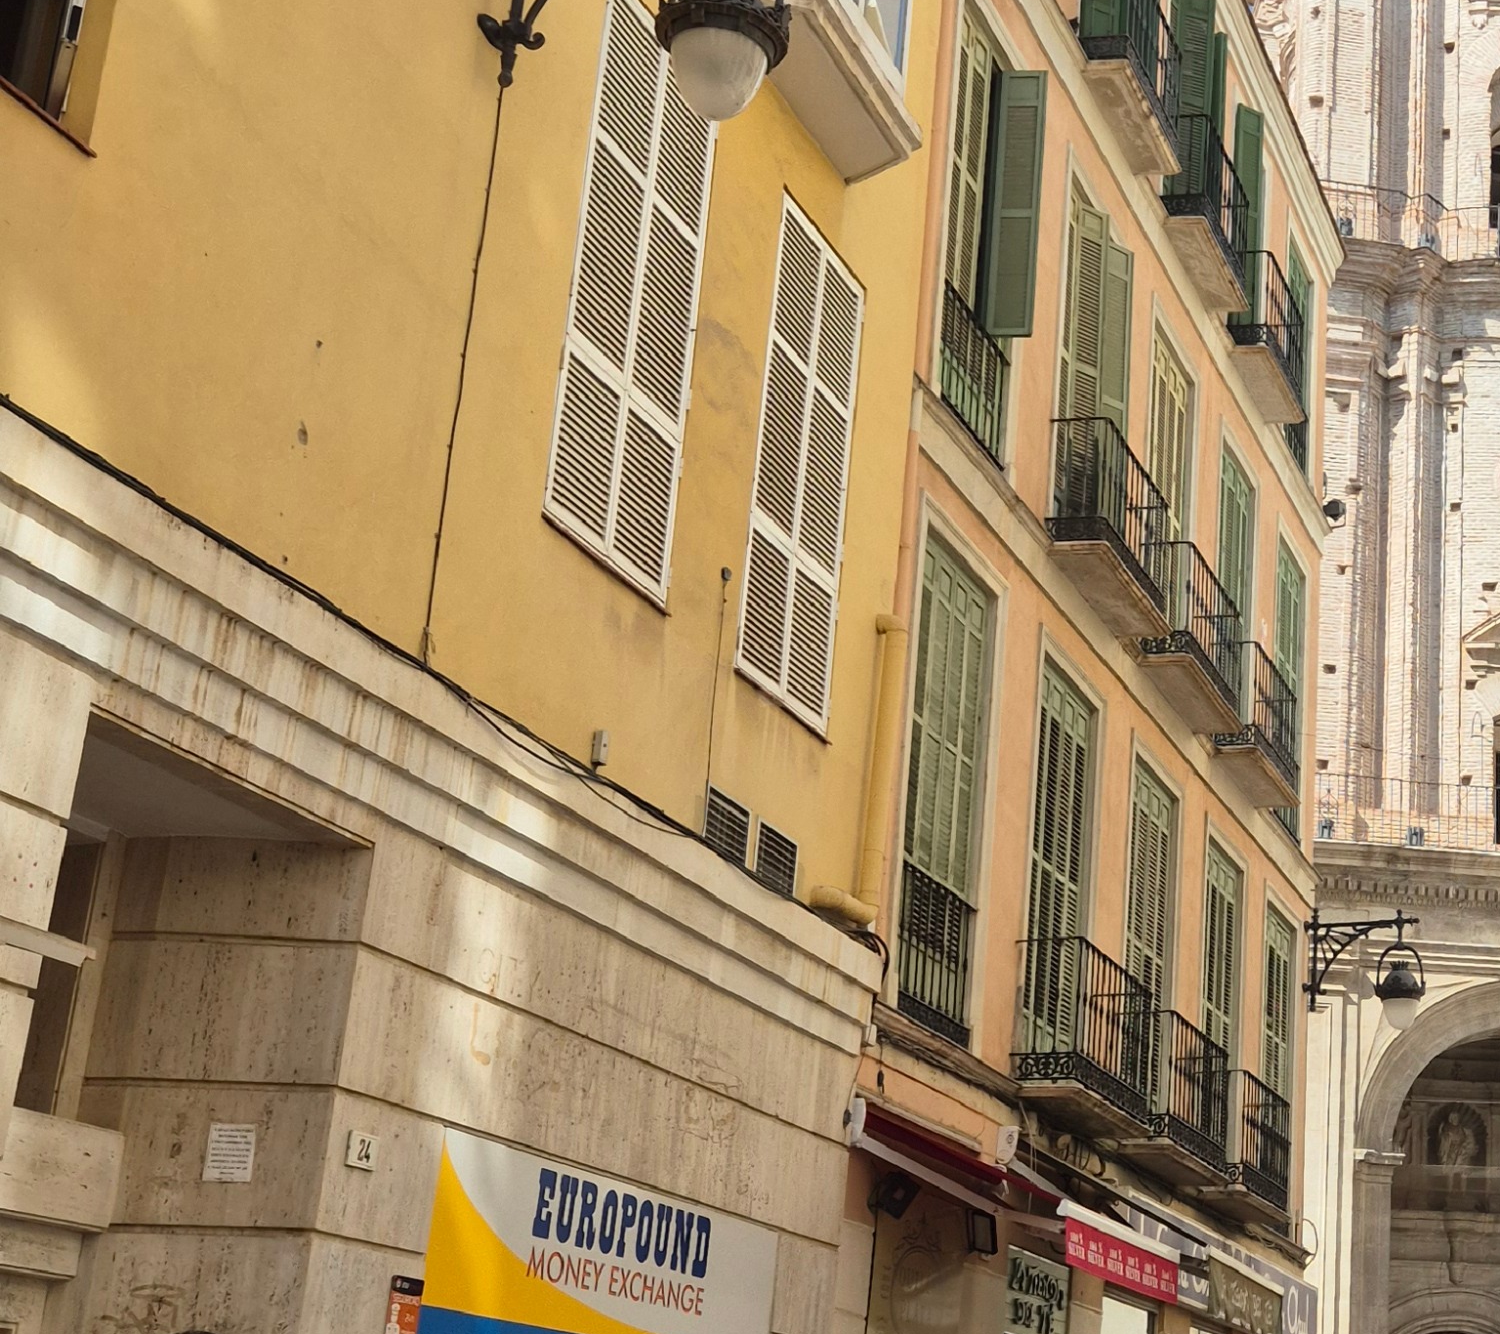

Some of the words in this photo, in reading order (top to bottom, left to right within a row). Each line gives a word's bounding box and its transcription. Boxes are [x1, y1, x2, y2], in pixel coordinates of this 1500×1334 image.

[357, 1138, 371, 1163] 24
[532, 1168, 711, 1278] EUROPOUND
[526, 1246, 605, 1292] MONEY
[608, 1265, 704, 1317] EXCHANGE
